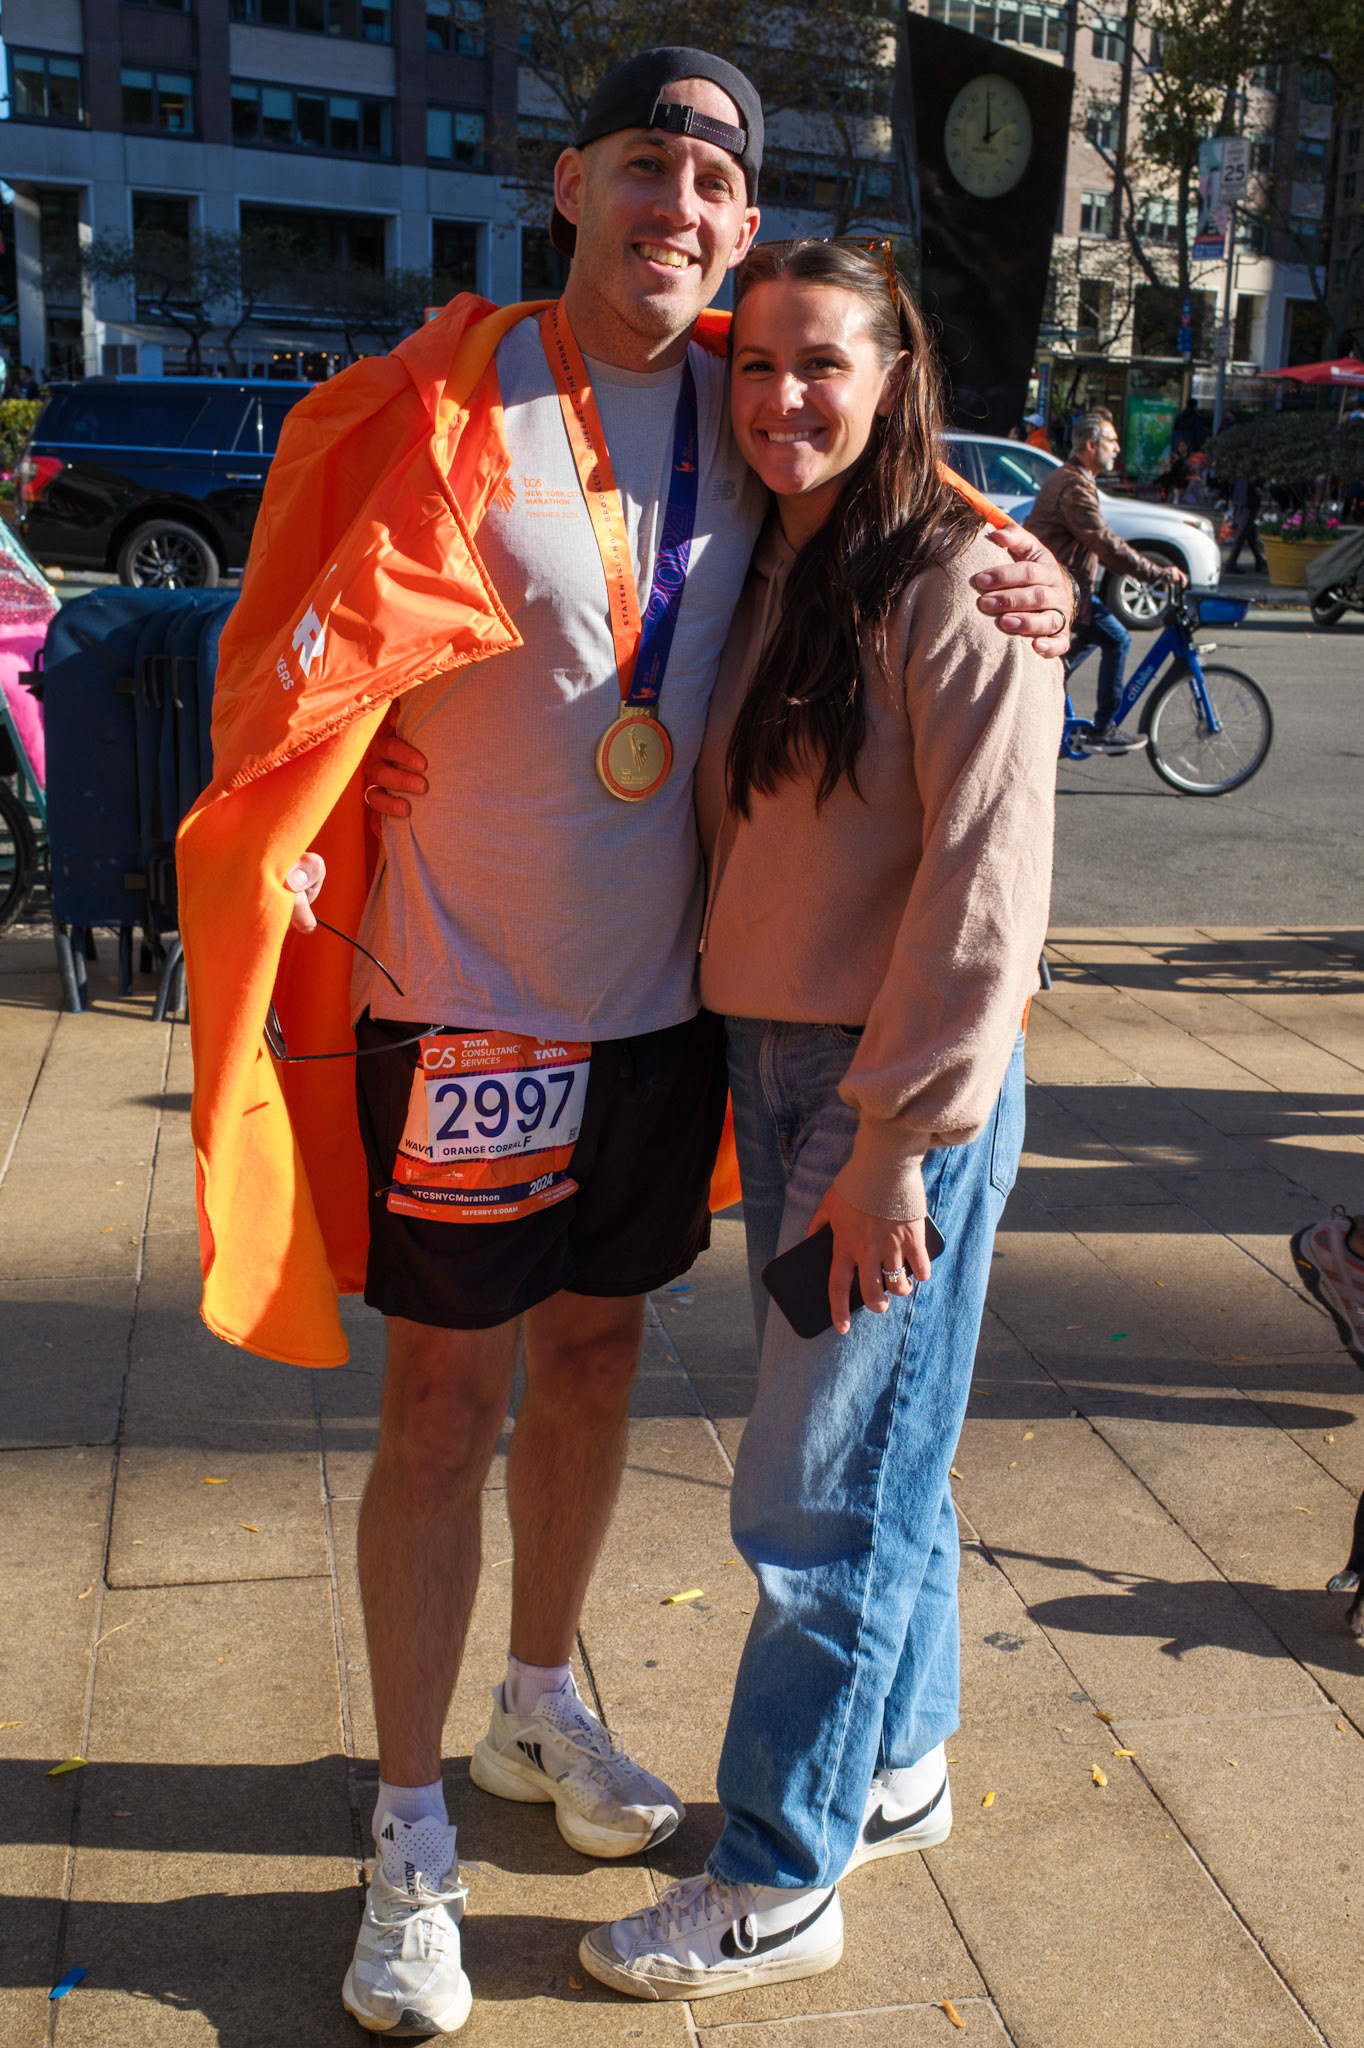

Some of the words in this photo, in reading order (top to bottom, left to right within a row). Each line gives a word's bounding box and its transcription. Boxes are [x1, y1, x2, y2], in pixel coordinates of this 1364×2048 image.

[1224, 164, 1245, 182] 25
[556, 339, 570, 372] BRONX
[566, 375, 577, 395] THE
[576, 409, 593, 451] QUEENS
[592, 466, 611, 523] BROOKLYN
[610, 538, 624, 579] ISLAND
[618, 583, 631, 626] STATEN
[462, 1039, 489, 1049] TATA
[534, 1047, 568, 1060] TATA
[461, 1057, 501, 1068] SERVICES
[434, 1071, 576, 1141] 2997
[427, 1145, 435, 1159] 1
[443, 1146, 486, 1156] ORANGE
[488, 1141, 522, 1154] CORRAL
[523, 1135, 532, 1148] F
[528, 1171, 554, 1196] 2024
[470, 1207, 492, 1216] FERRY
[493, 1206, 519, 1215] 6:00AM
[404, 1860, 420, 1912] ADIZEO
